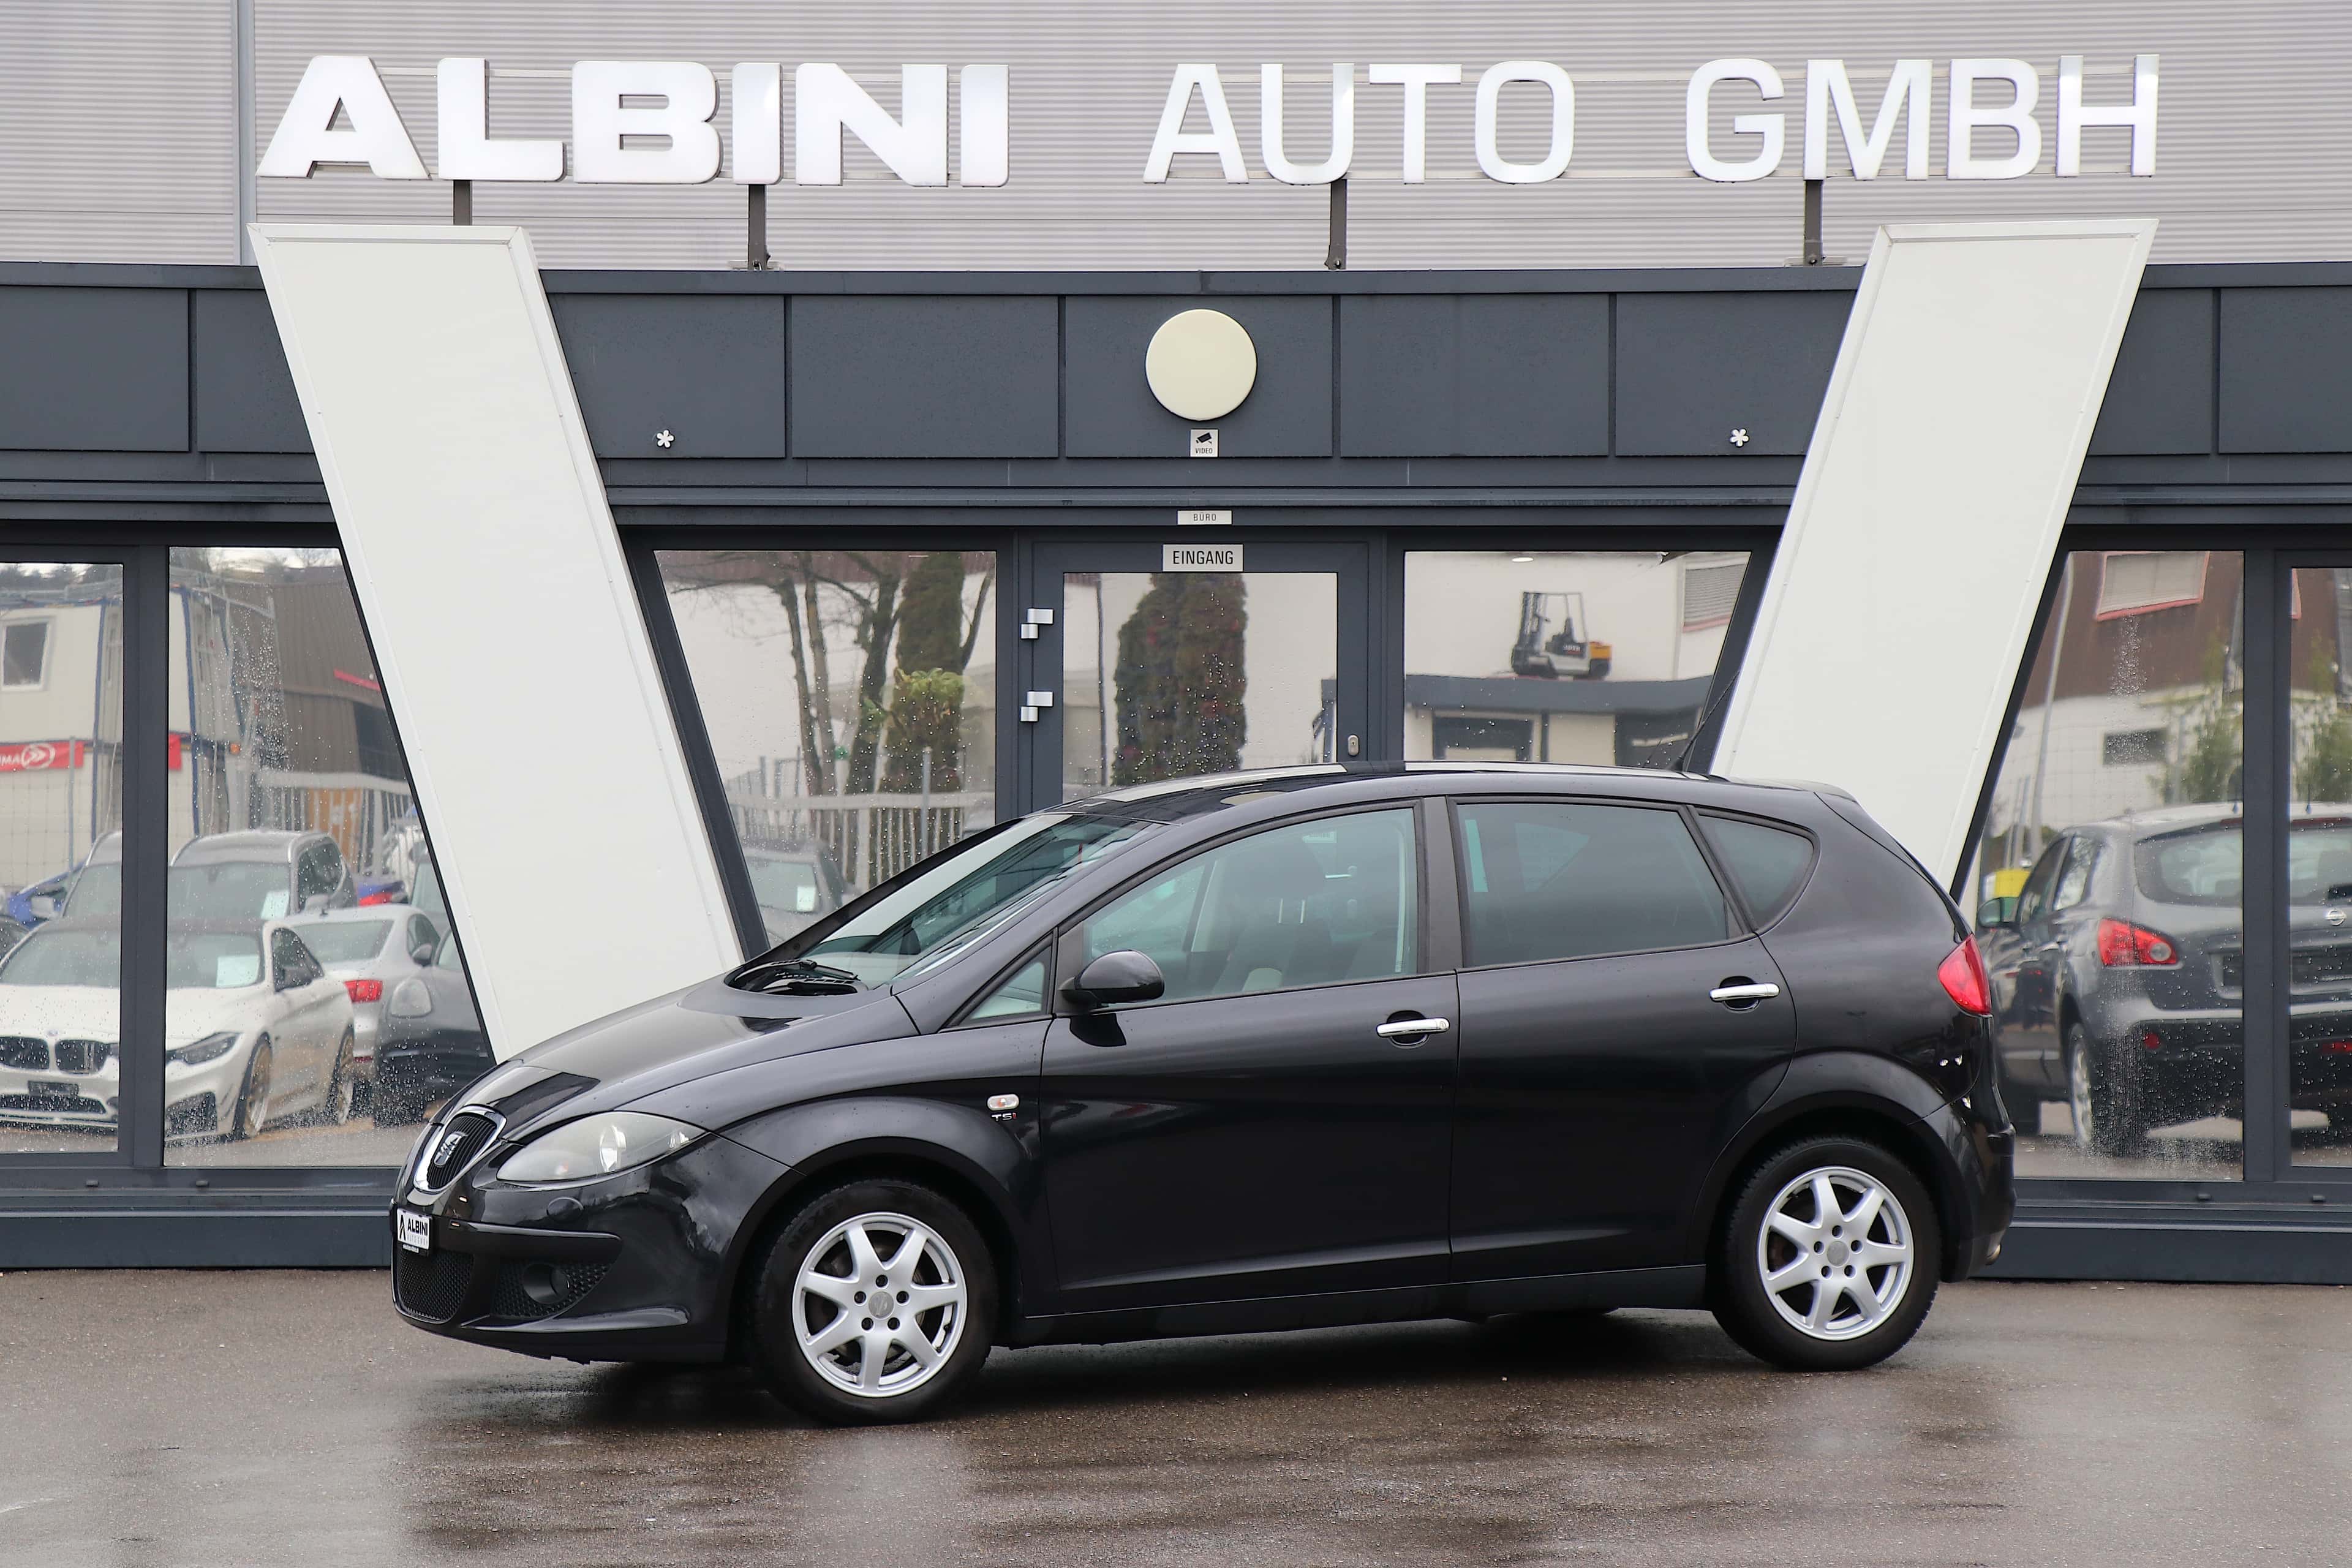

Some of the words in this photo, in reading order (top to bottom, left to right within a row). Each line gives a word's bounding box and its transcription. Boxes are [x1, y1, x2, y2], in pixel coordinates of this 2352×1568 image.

[255, 55, 1009, 187] ALBINI
[1143, 60, 1575, 185] AUTO
[1686, 54, 2159, 183] GMBH
[1193, 512, 1217, 521] BÜRO
[1172, 551, 1234, 565] EINGANG
[407, 1218, 428, 1236] ALBINI
